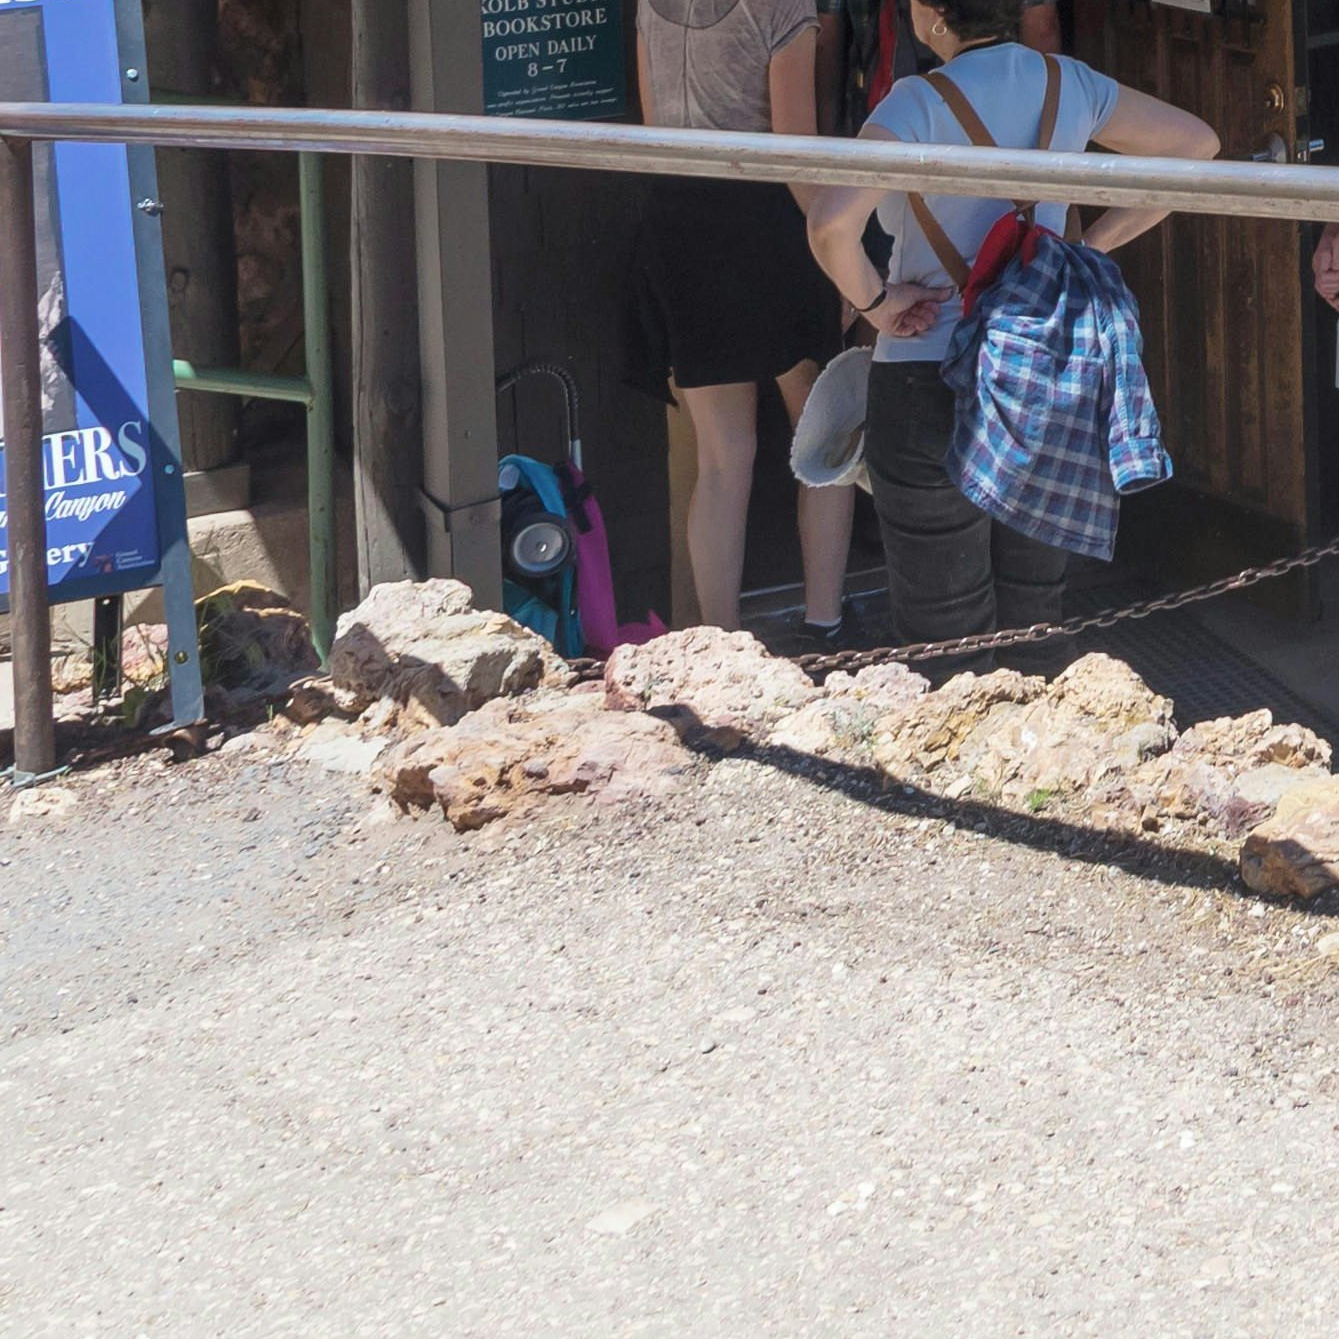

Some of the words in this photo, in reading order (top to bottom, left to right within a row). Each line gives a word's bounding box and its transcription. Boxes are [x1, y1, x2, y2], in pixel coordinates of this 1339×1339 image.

[483, 8, 607, 38] BOOKSTORE
[495, 41, 540, 61] OPEN
[548, 35, 597, 55] DAILY
[45, 490, 127, 522] Canyon
